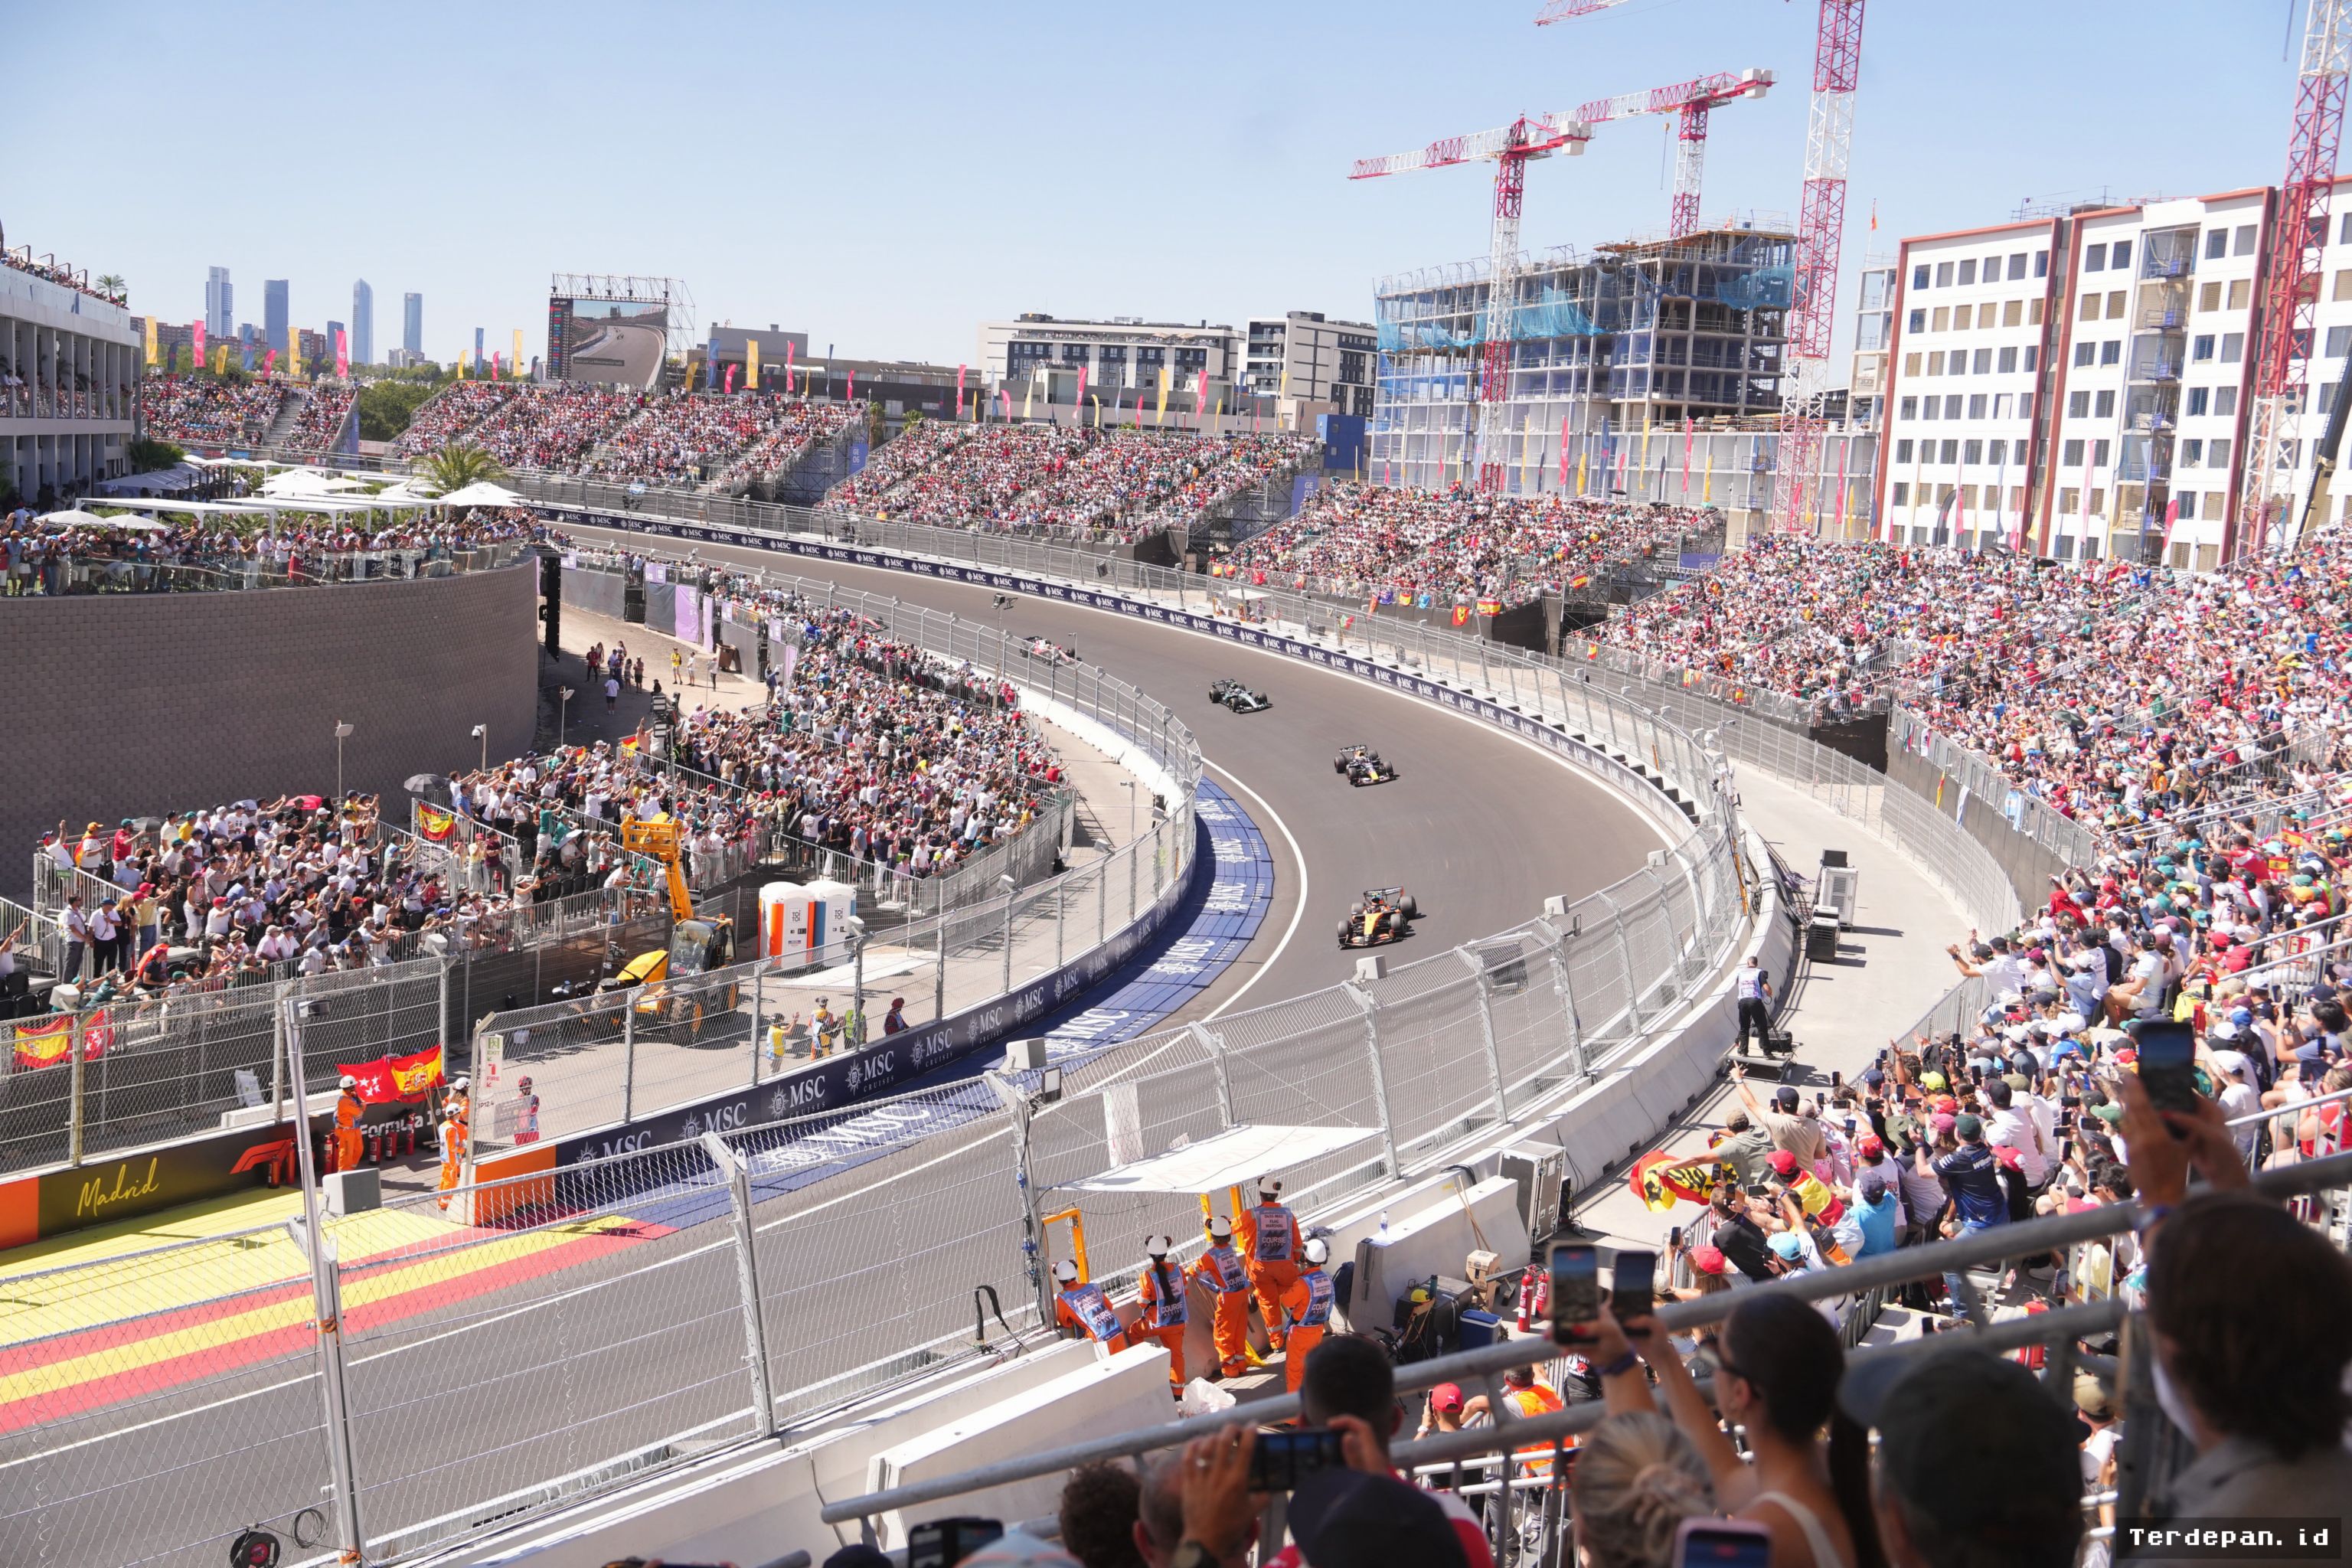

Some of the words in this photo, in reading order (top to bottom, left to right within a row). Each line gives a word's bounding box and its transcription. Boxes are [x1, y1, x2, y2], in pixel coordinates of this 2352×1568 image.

[1304, 490, 1314, 498] 07
[566, 512, 581, 521] MSC
[597, 515, 612, 524] MSC
[628, 519, 642, 528] MSC
[658, 524, 674, 532] MSC
[688, 528, 704, 536] MSC
[717, 532, 733, 541] MSC
[747, 537, 763, 545] MSC
[776, 541, 791, 549] MSC
[805, 545, 820, 554] MSC
[834, 550, 848, 558] MSC
[862, 554, 877, 563] MSC
[890, 558, 904, 567] MSC
[917, 563, 932, 572] MSC
[945, 567, 959, 577] MSC
[972, 572, 986, 582] MSC
[999, 577, 1012, 586] MSC
[1026, 582, 1039, 592] MSC
[1051, 586, 1064, 596] MSC
[1076, 591, 1090, 602] MSC
[1101, 596, 1114, 606] MSC
[1126, 601, 1139, 612] MSC
[1150, 606, 1163, 618] MSC
[1174, 612, 1187, 624] MSC
[1197, 618, 1210, 629] MSC
[1221, 624, 1233, 636] MSC
[1244, 630, 1257, 642] MSC
[1267, 637, 1280, 649] MSC
[1290, 643, 1302, 655] MSC
[1313, 650, 1325, 662] MSC
[1335, 656, 1348, 668] MSC
[1357, 664, 1370, 675] MSC
[1379, 671, 1391, 682] MSC
[1400, 678, 1413, 689] MSC
[1158, 939, 1215, 962] MSC
[1095, 950, 1108, 972] MSC
[1064, 967, 1079, 992] MSC
[1025, 986, 1044, 1012] MSC
[980, 1007, 1002, 1034] MSC
[1045, 1008, 1129, 1040] MSC
[926, 1028, 952, 1057] MSC
[926, 1051, 952, 1066] CRUISES
[864, 1050, 894, 1081] MSC
[864, 1075, 894, 1092] CRUISES
[790, 1075, 825, 1108] MSC
[790, 1102, 825, 1119] CRUISES
[704, 1102, 746, 1133] MSC
[361, 1115, 423, 1138] Formua
[801, 1105, 930, 1147] MSC
[603, 1130, 651, 1166] MSC
[77, 1158, 159, 1216] Madrid
[1161, 1302, 1183, 1313] COURSE
